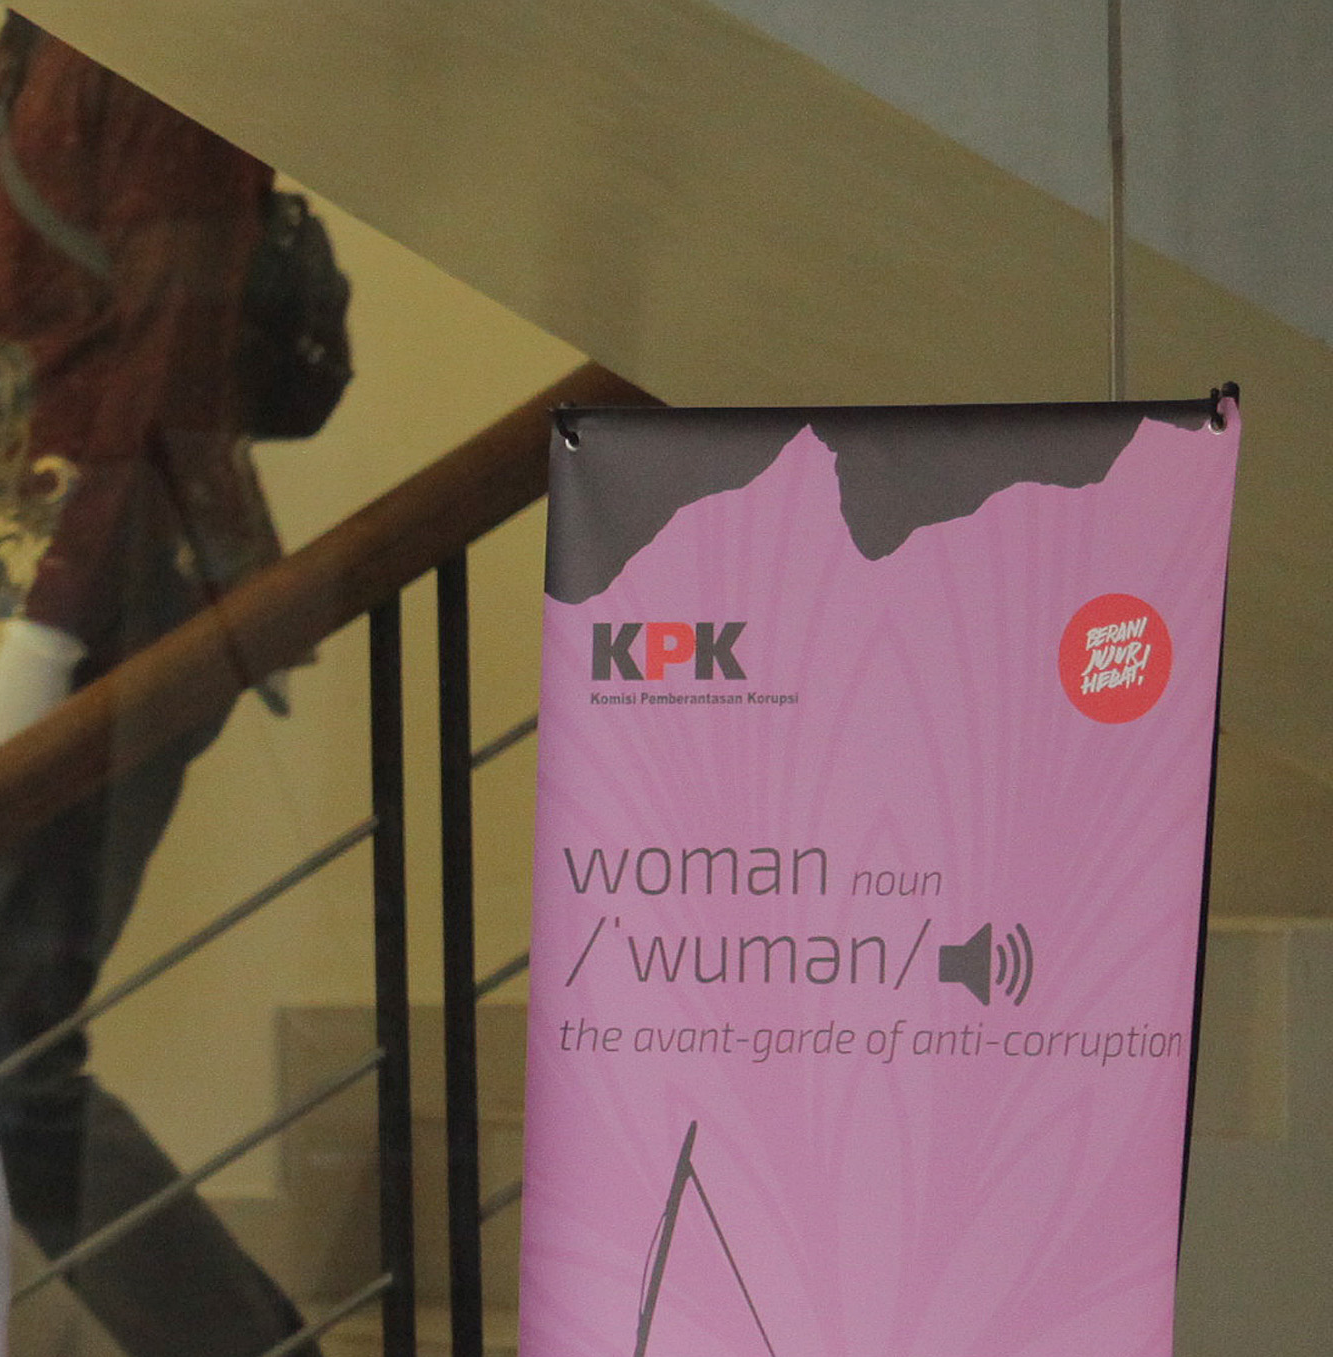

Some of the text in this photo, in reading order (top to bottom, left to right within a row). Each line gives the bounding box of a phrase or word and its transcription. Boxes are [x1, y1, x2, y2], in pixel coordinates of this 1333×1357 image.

[592, 622, 748, 681] KPK
[1086, 616, 1147, 651] BERANI
[590, 692, 799, 706] Komisi Pemberantasan Korupsi
[563, 847, 942, 896] woman noun
[560, 1017, 1182, 1067] the avant-garde of anti-corruption
